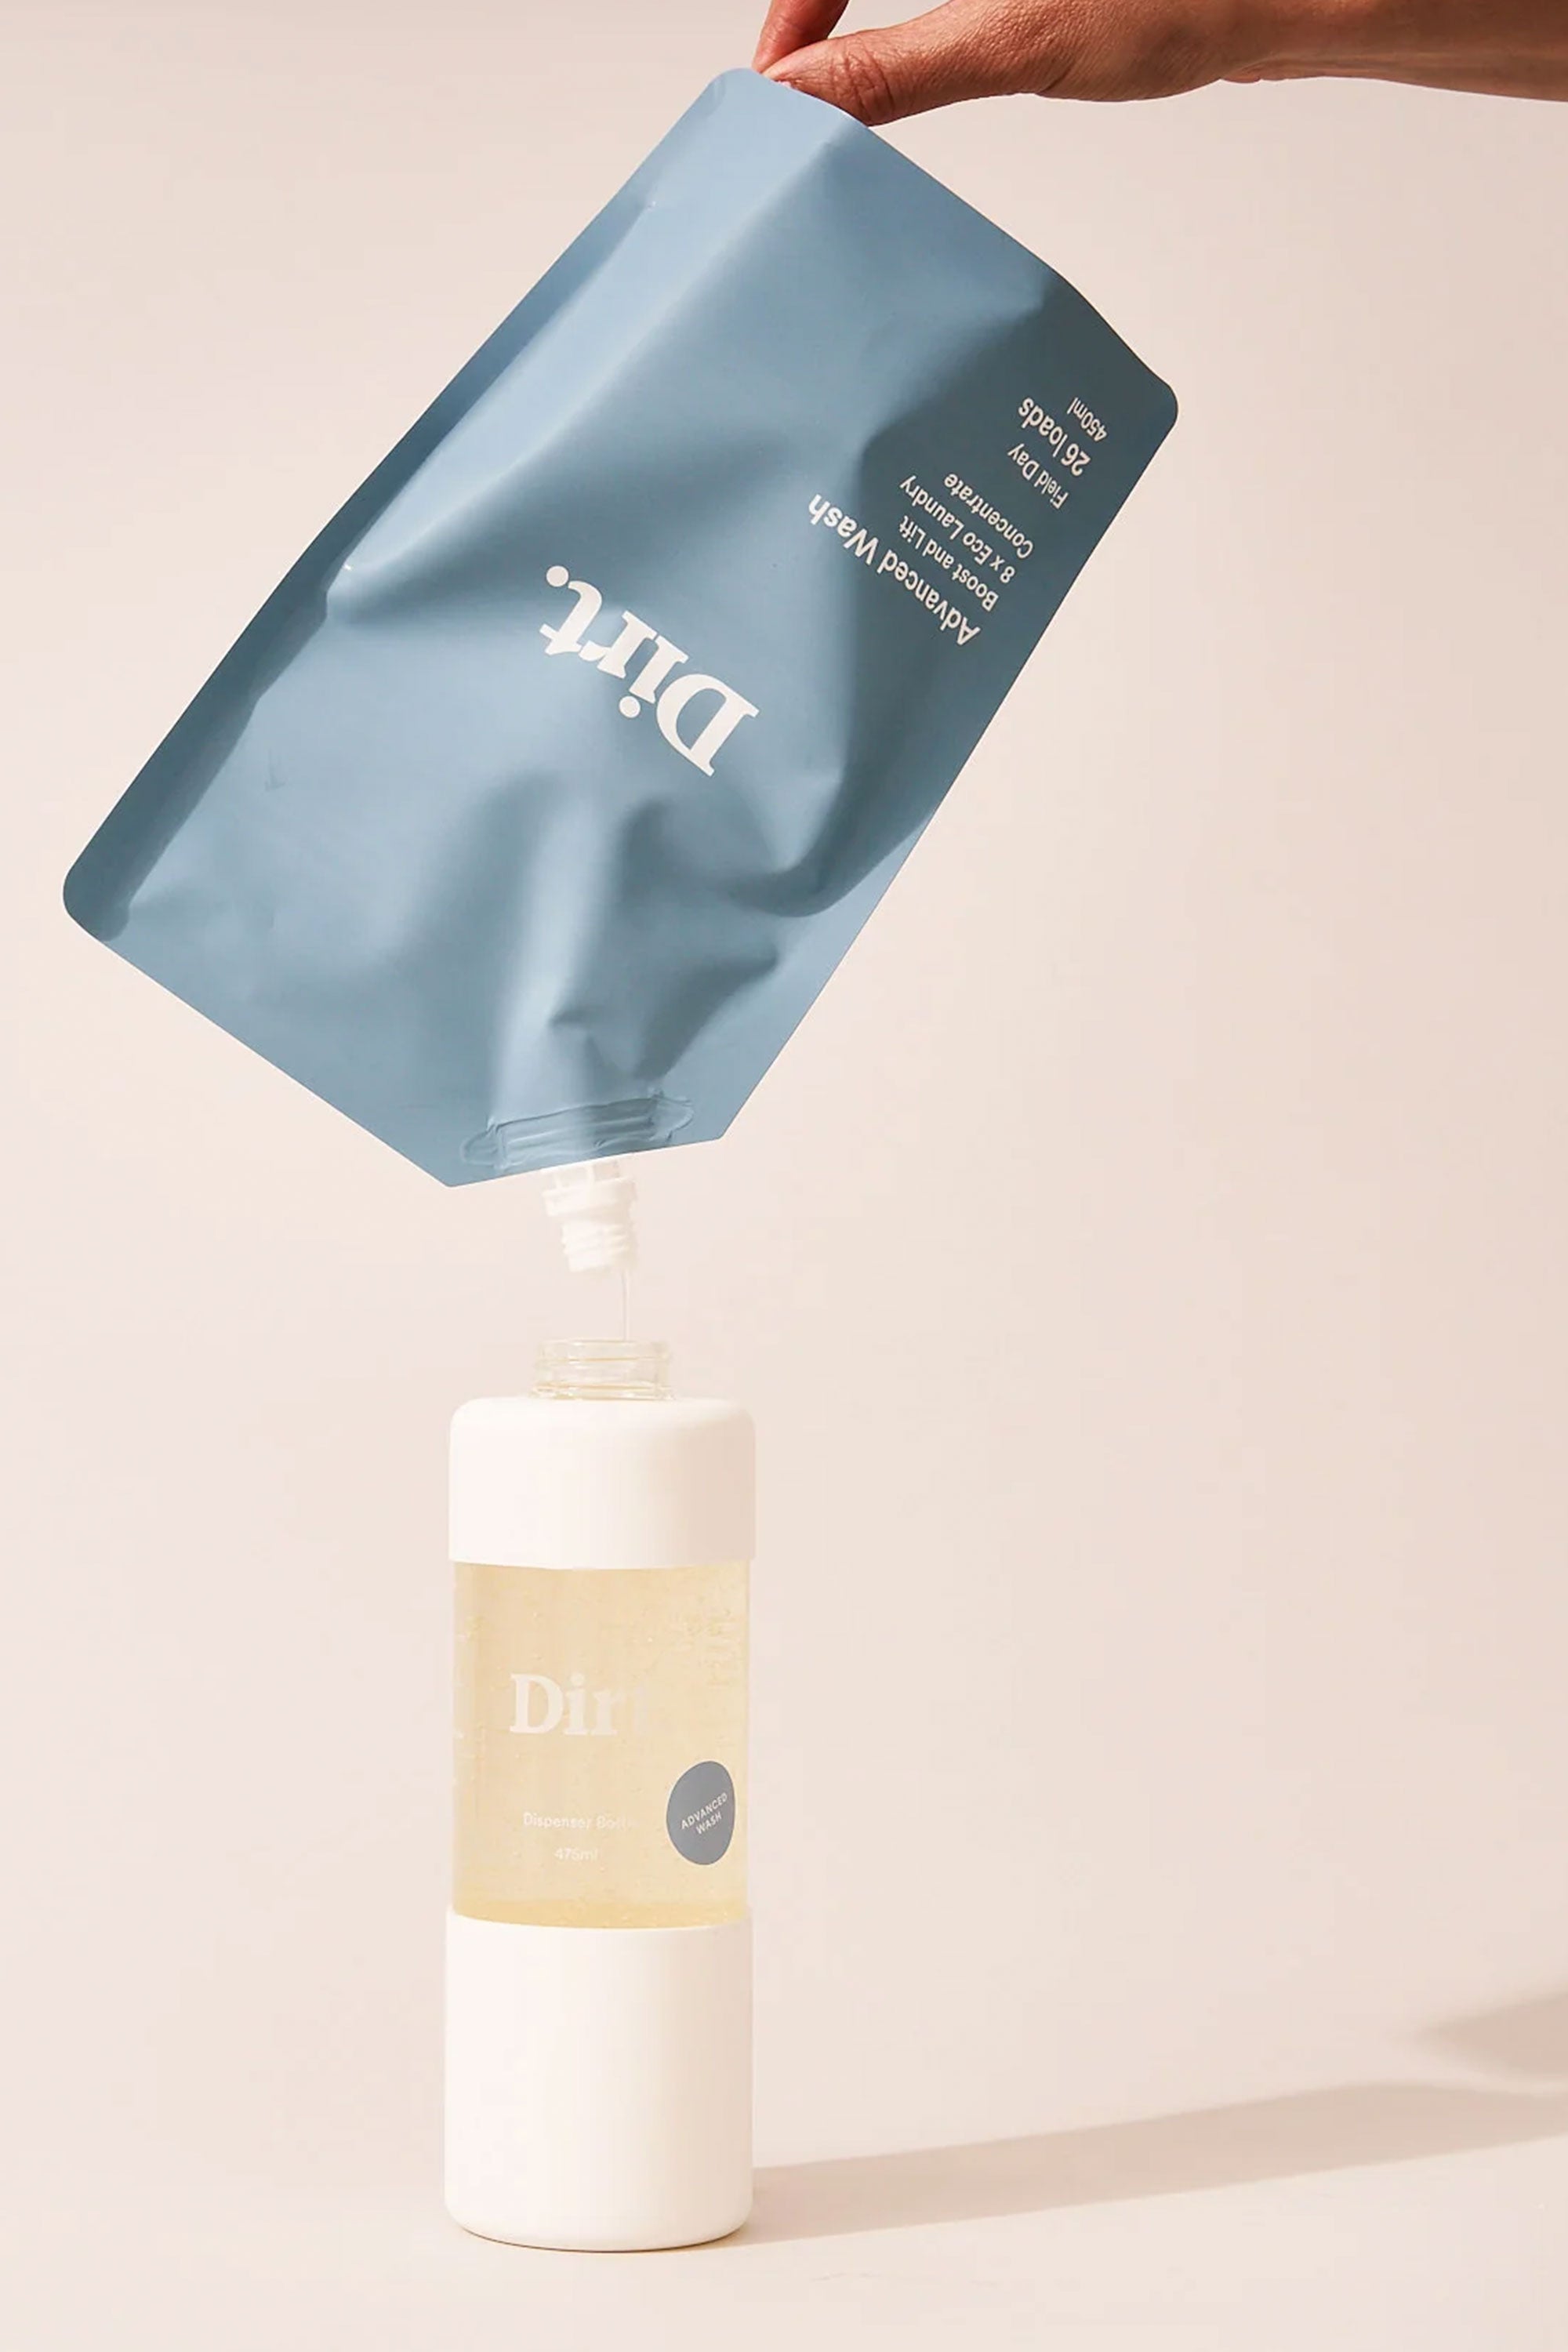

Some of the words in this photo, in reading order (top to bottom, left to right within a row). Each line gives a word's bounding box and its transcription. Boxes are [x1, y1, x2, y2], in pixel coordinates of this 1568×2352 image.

[1018, 397, 1068, 458] loads
[1067, 397, 1108, 443] 450ml
[1007, 443, 1040, 479] Day
[1061, 443, 1091, 477] 26
[899, 475, 964, 540] Laundry
[1034, 474, 1069, 510] Field
[808, 494, 879, 565] Wash
[898, 515, 926, 548] Lift
[943, 473, 1034, 559] Concentrate
[924, 538, 953, 568] and
[963, 531, 993, 562] Eco
[990, 557, 1006, 570] x
[952, 568, 1000, 612] Boost
[1000, 567, 1016, 583] 8
[877, 549, 981, 645] Advanced
[539, 565, 760, 777] Dirt.
[523, 1812, 591, 1828] Dispenser
[681, 1791, 728, 1831] ADVANCED
[696, 1812, 722, 1835] WASH
